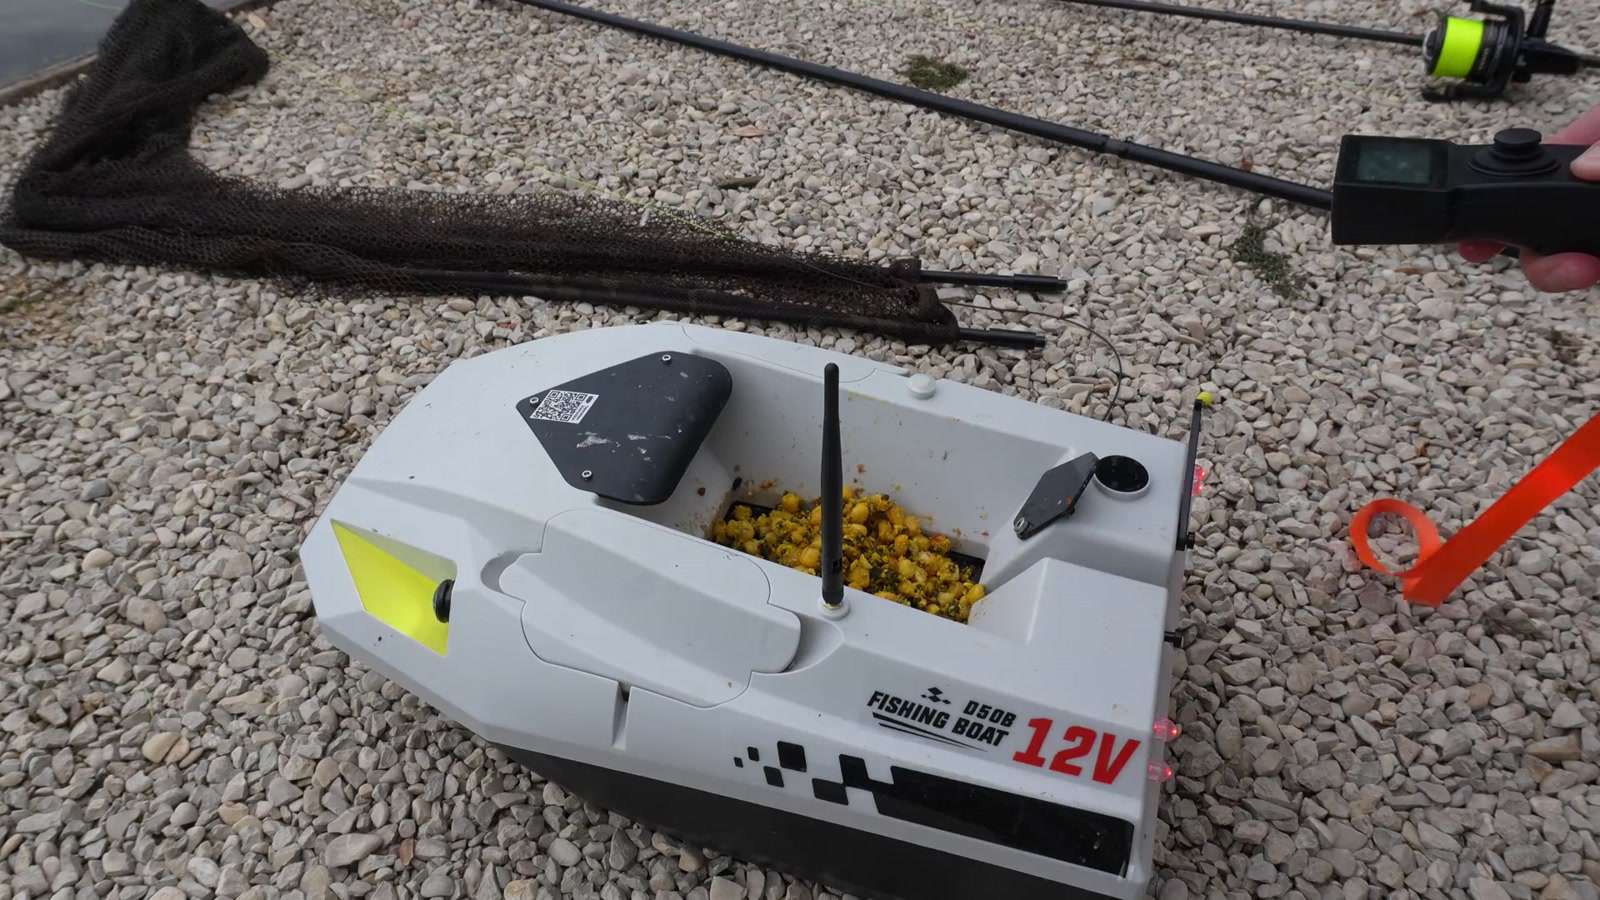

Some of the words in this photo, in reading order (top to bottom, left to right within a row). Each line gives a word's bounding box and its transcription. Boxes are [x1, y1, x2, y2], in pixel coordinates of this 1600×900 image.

[867, 691, 949, 728] FISHING
[952, 717, 1009, 747] BOAT
[963, 700, 1016, 727] D50B
[1012, 717, 1141, 785] 12V
